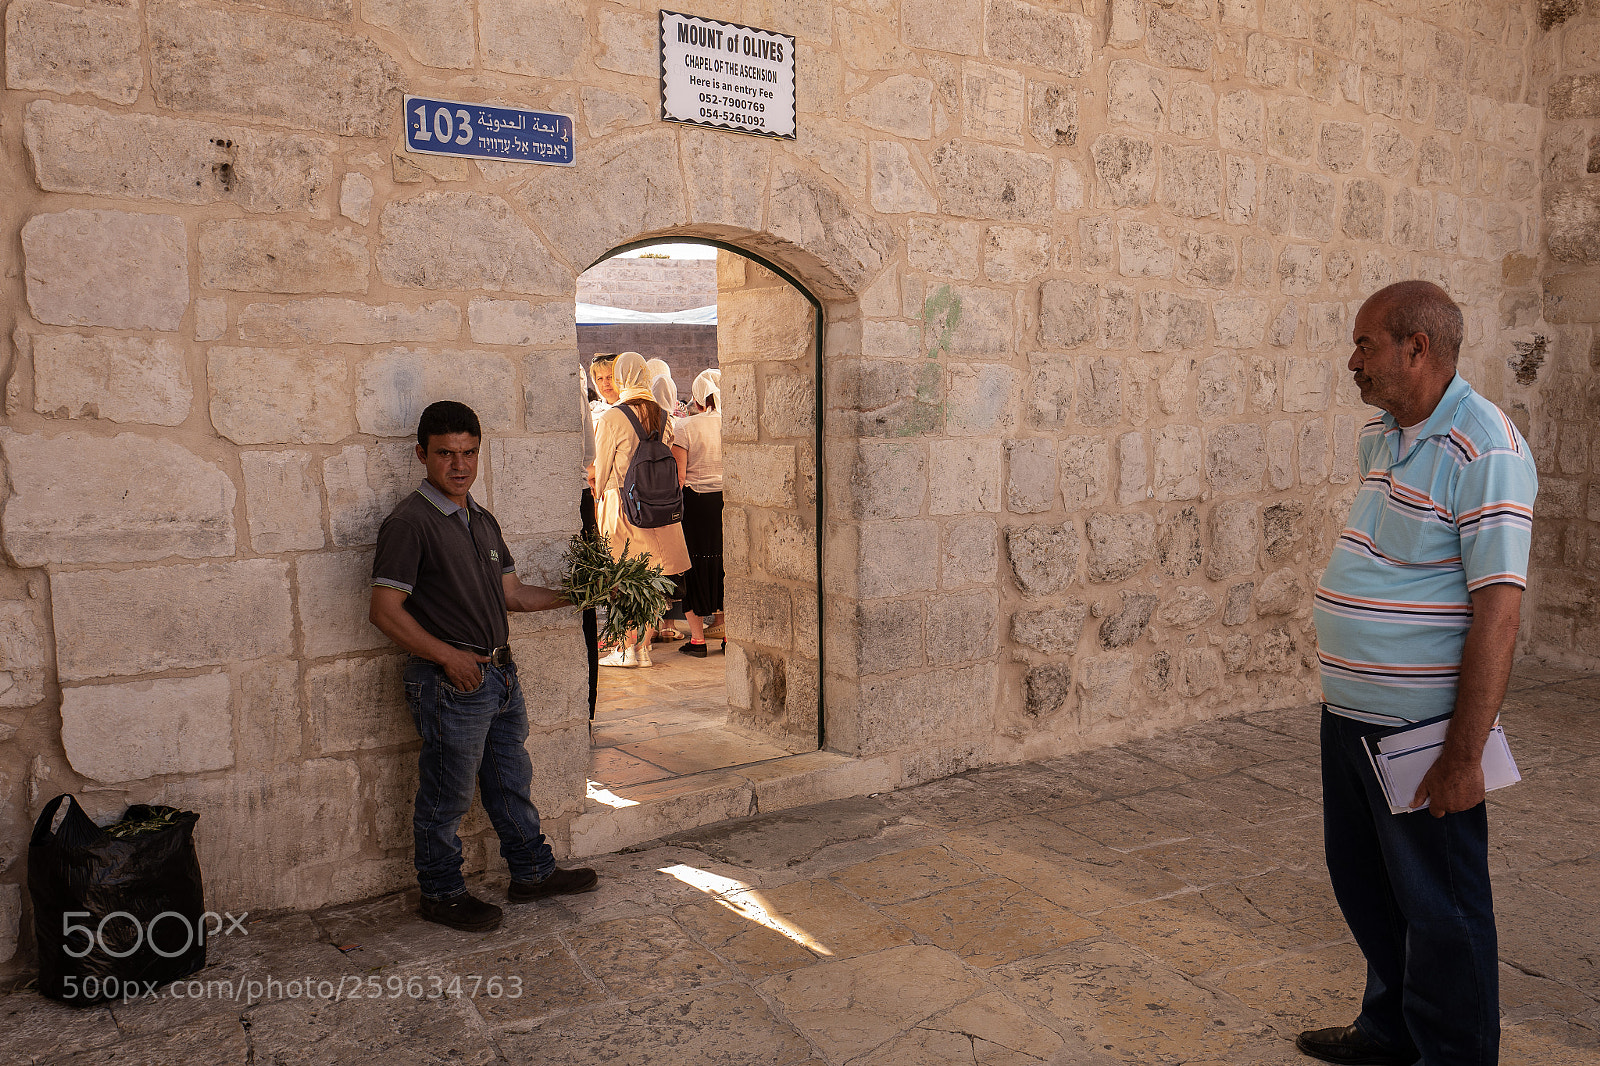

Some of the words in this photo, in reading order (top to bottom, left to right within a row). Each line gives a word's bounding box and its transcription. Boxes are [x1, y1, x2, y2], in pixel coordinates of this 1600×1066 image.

[677, 22, 724, 50] MOUNT
[727, 34, 739, 54] of
[743, 35, 784, 63] OLIVES
[685, 53, 713, 72] CHAPEL
[713, 59, 724, 74] OF
[724, 61, 739, 77] THE
[739, 64, 777, 84] ASCENSION
[689, 74, 711, 88] Here
[712, 78, 720, 89] is
[722, 81, 733, 92] an
[734, 84, 757, 98] entry
[759, 87, 774, 99] Fee
[698, 92, 766, 113] 052-7900769
[413, 104, 474, 146] 103
[699, 107, 766, 127] 054-5261092
